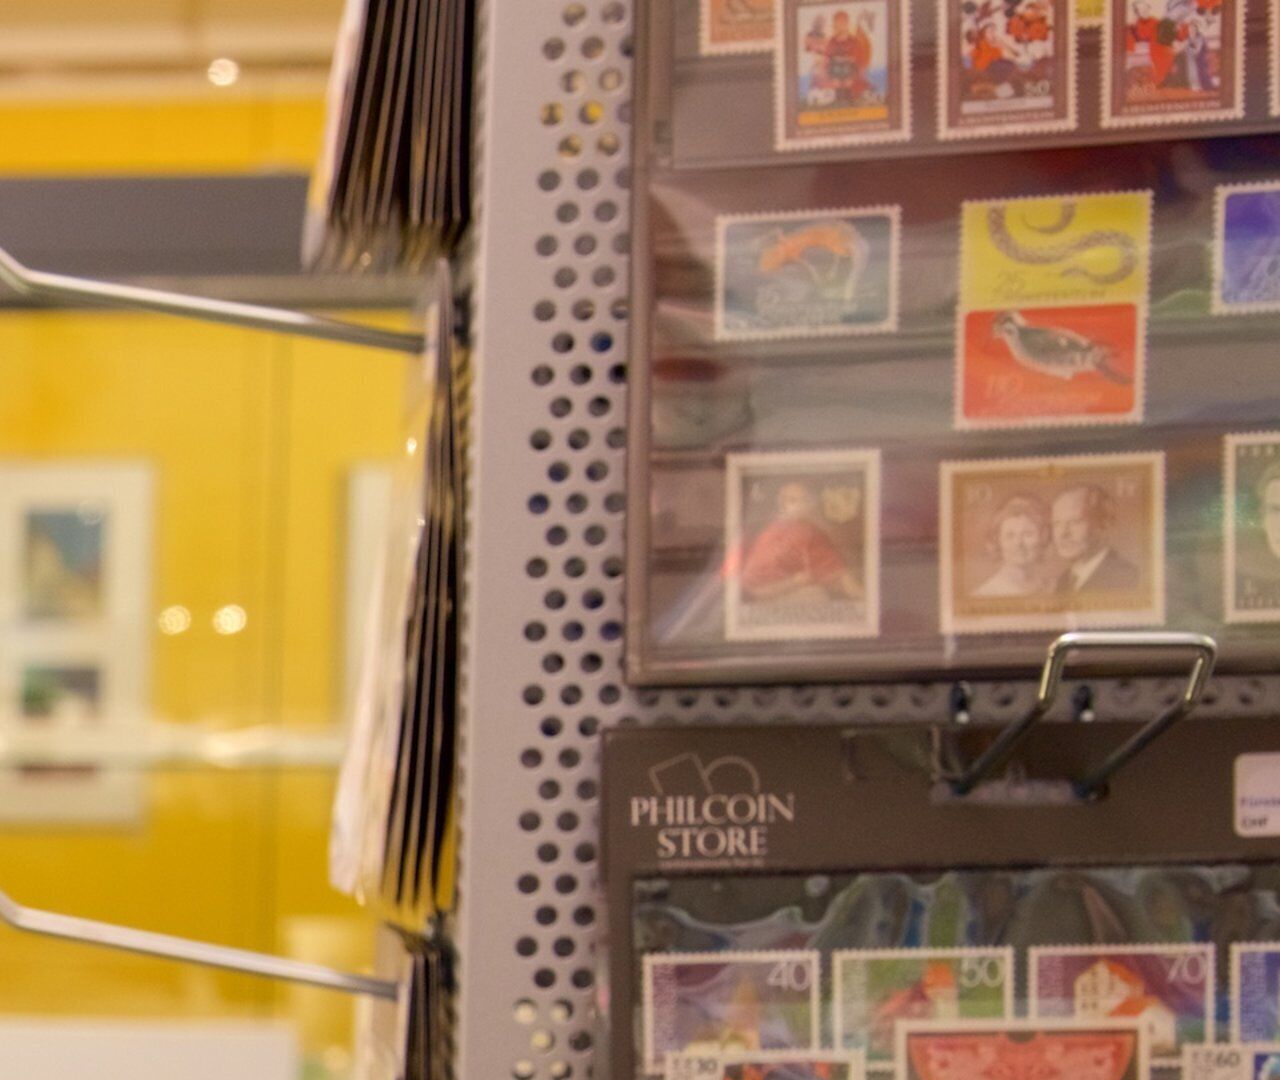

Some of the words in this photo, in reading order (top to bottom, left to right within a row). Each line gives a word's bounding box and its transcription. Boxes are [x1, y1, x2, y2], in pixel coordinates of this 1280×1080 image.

[630, 792, 794, 826] PHILCOIN
[657, 826, 768, 858] STORE
[766, 960, 810, 991] 40
[959, 956, 1004, 987] 50
[1168, 953, 1207, 984] 70
